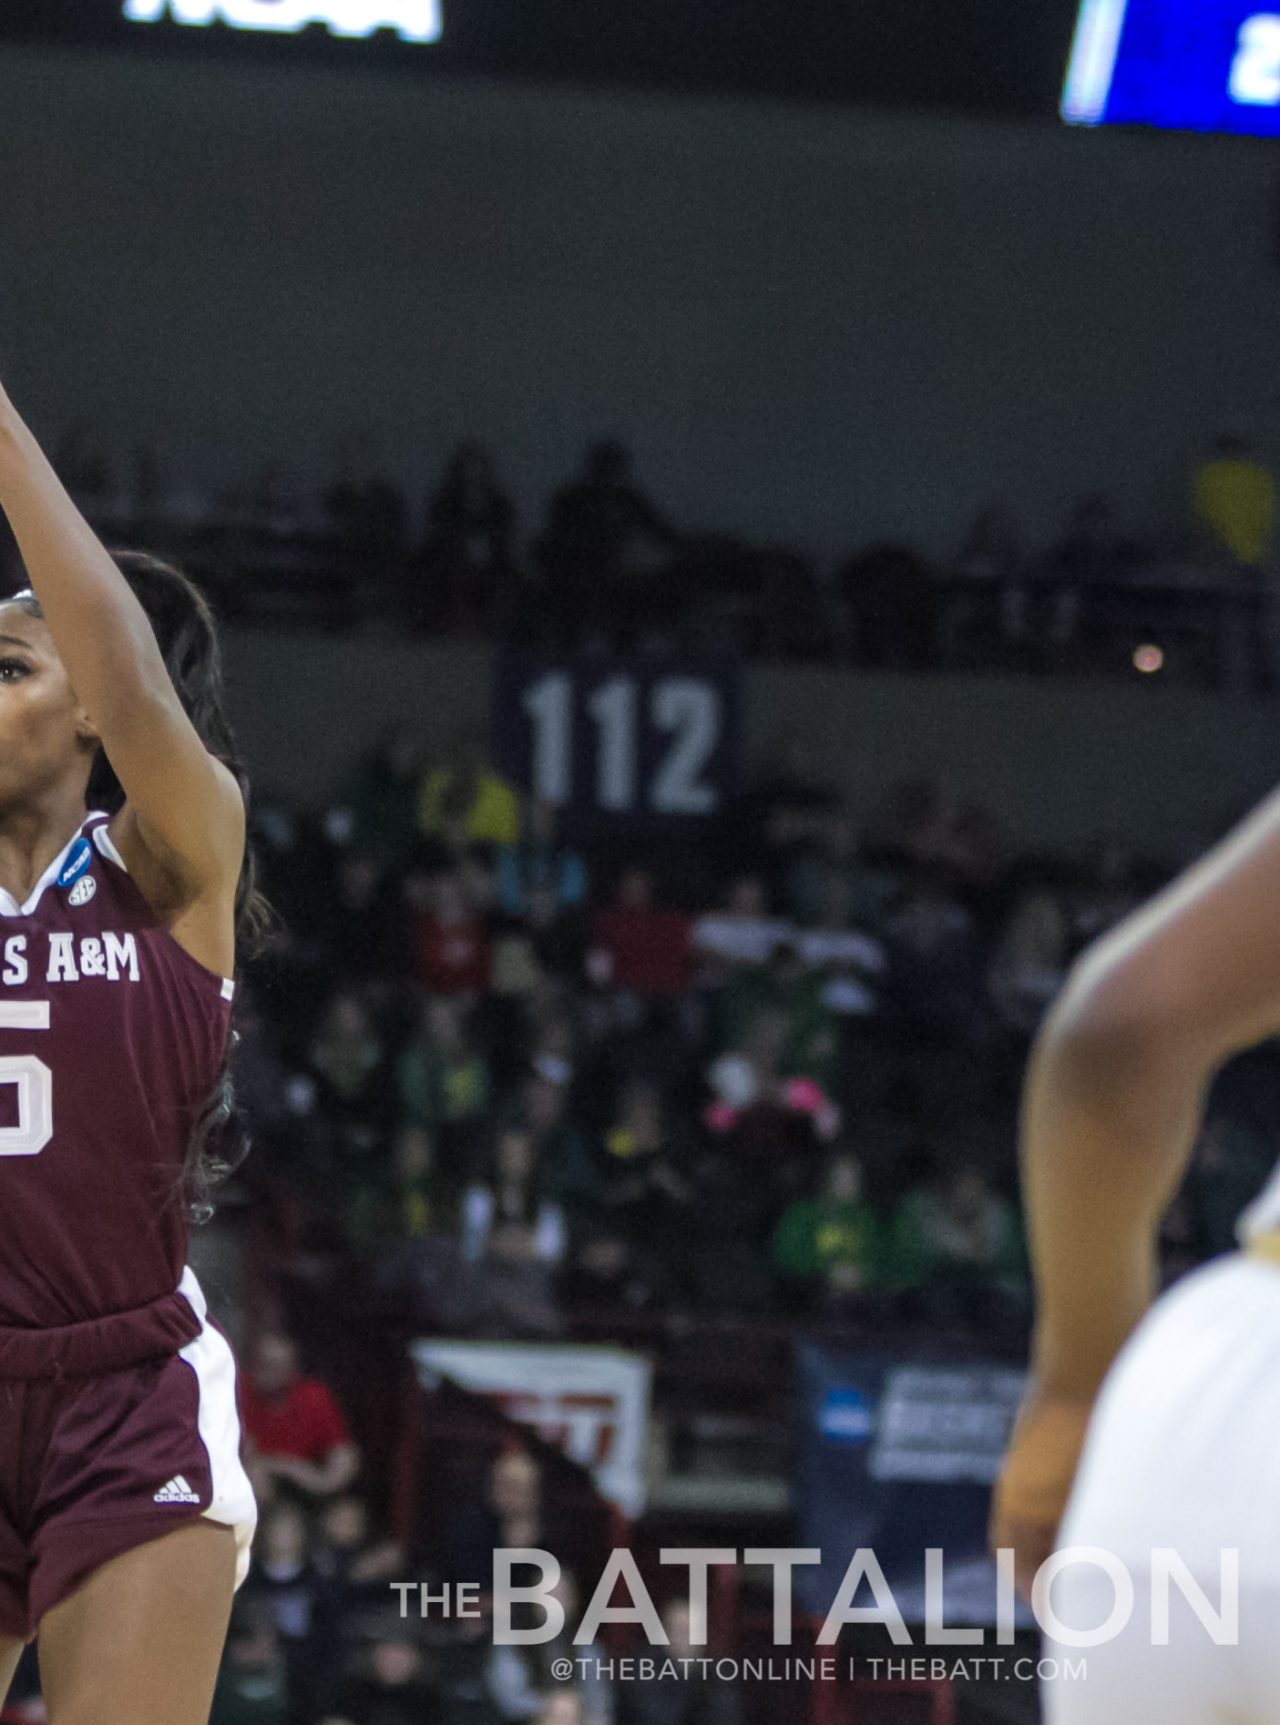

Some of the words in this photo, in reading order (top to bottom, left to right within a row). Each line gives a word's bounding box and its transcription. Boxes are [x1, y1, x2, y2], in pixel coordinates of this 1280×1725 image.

[524, 672, 719, 814] 112
[46, 931, 141, 982] A&M
[153, 1493, 200, 1503] adidas
